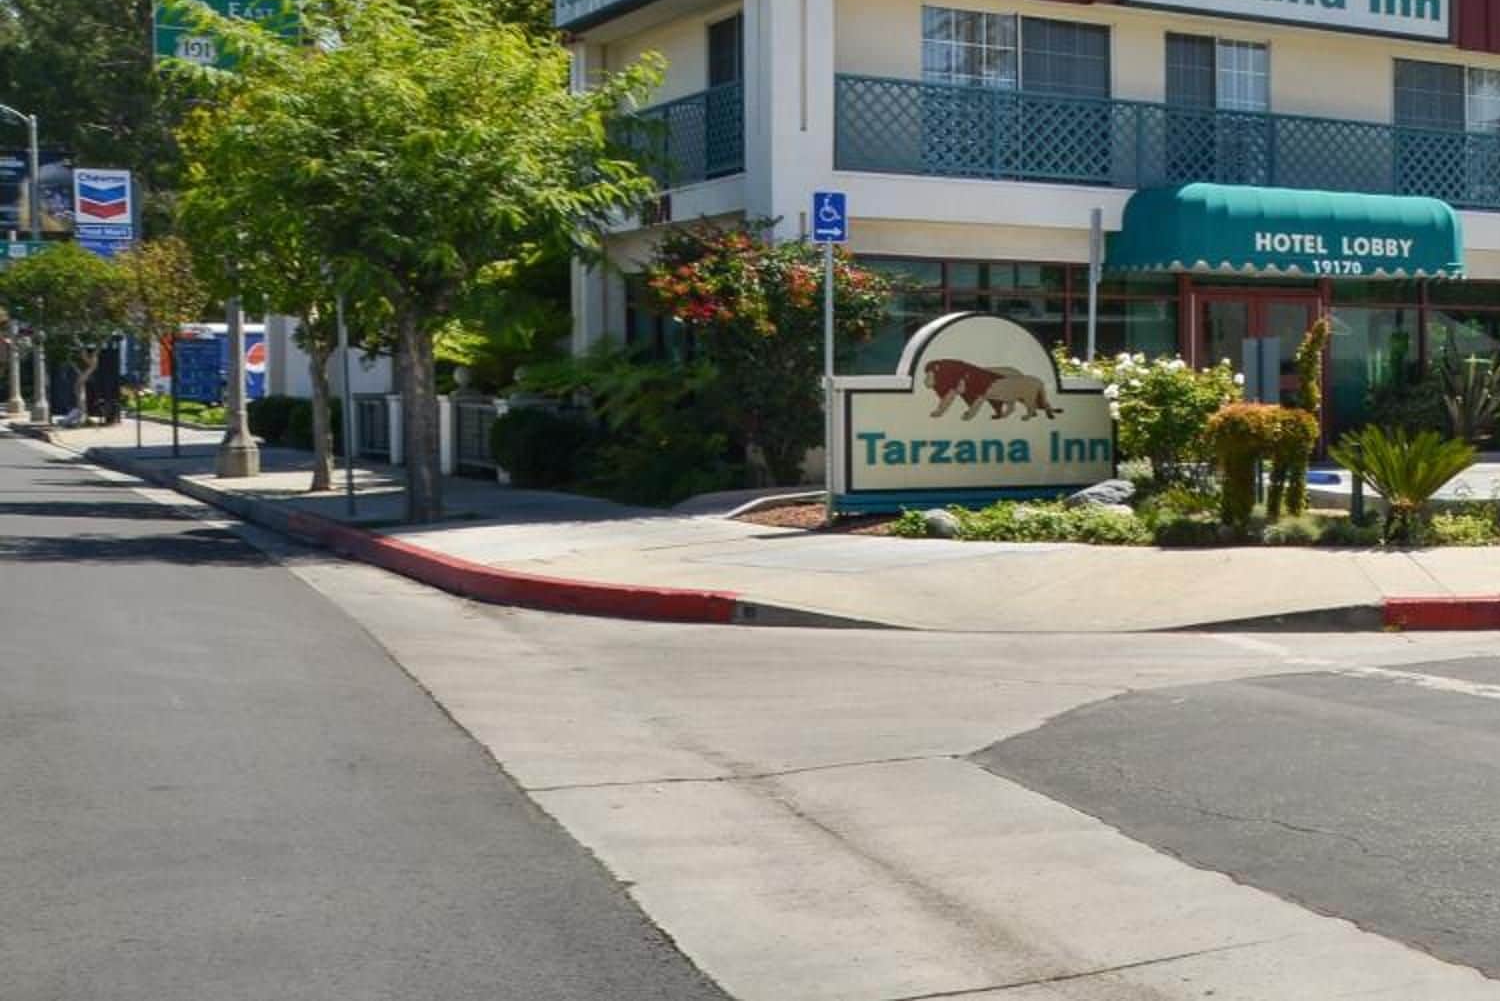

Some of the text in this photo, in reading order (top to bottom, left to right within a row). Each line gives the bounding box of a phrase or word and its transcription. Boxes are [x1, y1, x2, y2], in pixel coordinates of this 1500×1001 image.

[1255, 232, 1413, 257] HOTEL LOBBY
[1312, 260, 1362, 274] 19170
[857, 430, 1111, 465] Tarzana Inn
